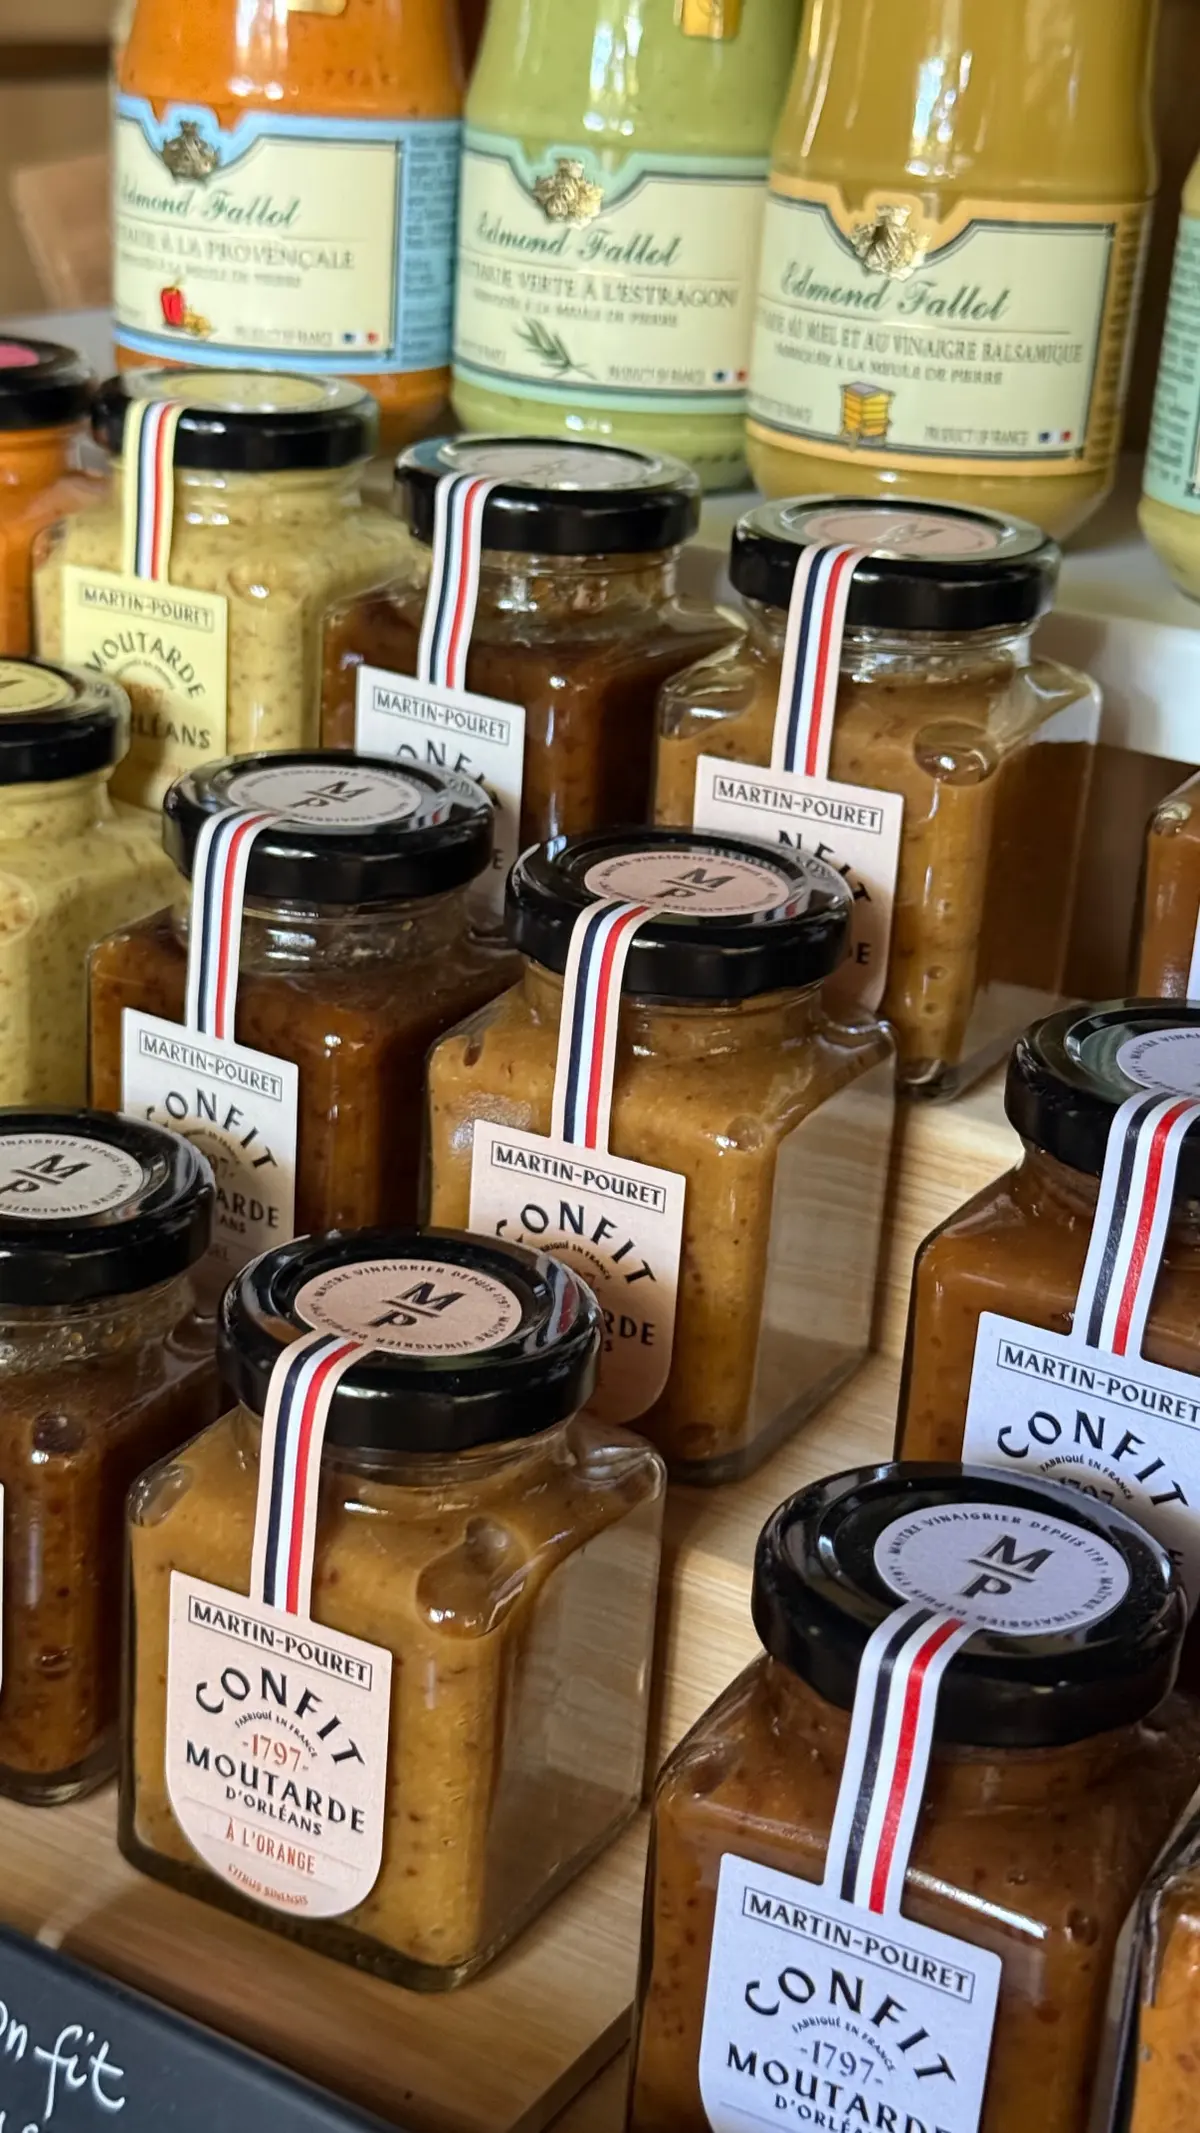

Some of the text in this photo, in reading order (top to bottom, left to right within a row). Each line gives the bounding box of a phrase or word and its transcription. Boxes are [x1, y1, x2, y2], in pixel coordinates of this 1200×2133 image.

[780, 260, 893, 312] Edmond
[83, 587, 210, 628] MARTIN-POURET
[376, 691, 505, 740] MARTIN-POURET
[718, 779, 879, 829] MARTIN-POURET
[676, 867, 736, 889] M
[143, 1034, 281, 1096] MARTIN-POURET
[26, 1153, 93, 1179] M
[496, 1146, 662, 1206] MARTIN-POURET
[216, 1186, 280, 1229] ARDE
[366, 1309, 418, 1329] P
[395, 1281, 467, 1312] M
[1004, 1345, 1200, 1425] MARTIN-POURET
[996, 1408, 1190, 1508] CONFIT
[1038, 1453, 1135, 1501] FABRIQUÉ EN FRANCE
[920, 1511, 1023, 1527] VINAIGRIER
[1028, 1520, 1087, 1548] DEPUIS
[984, 1533, 1056, 1574] M
[960, 1572, 1013, 1599] P
[193, 1600, 369, 1684] MARTIN-POURET
[195, 1666, 367, 1768] CONFIT
[233, 1709, 319, 1759] FABRIQUÉ EN FRANCE
[186, 1738, 366, 1834] MOUTARDE
[225, 1784, 323, 1836] D'ORLÉANS
[224, 1815, 317, 1876] À L'ORANGE
[749, 1894, 970, 1996] MARTIN-POURET
[743, 1965, 958, 2084] CONFIT
[791, 2015, 842, 2035] FABRIQUÉ
[844, 2020, 860, 2037] EN
